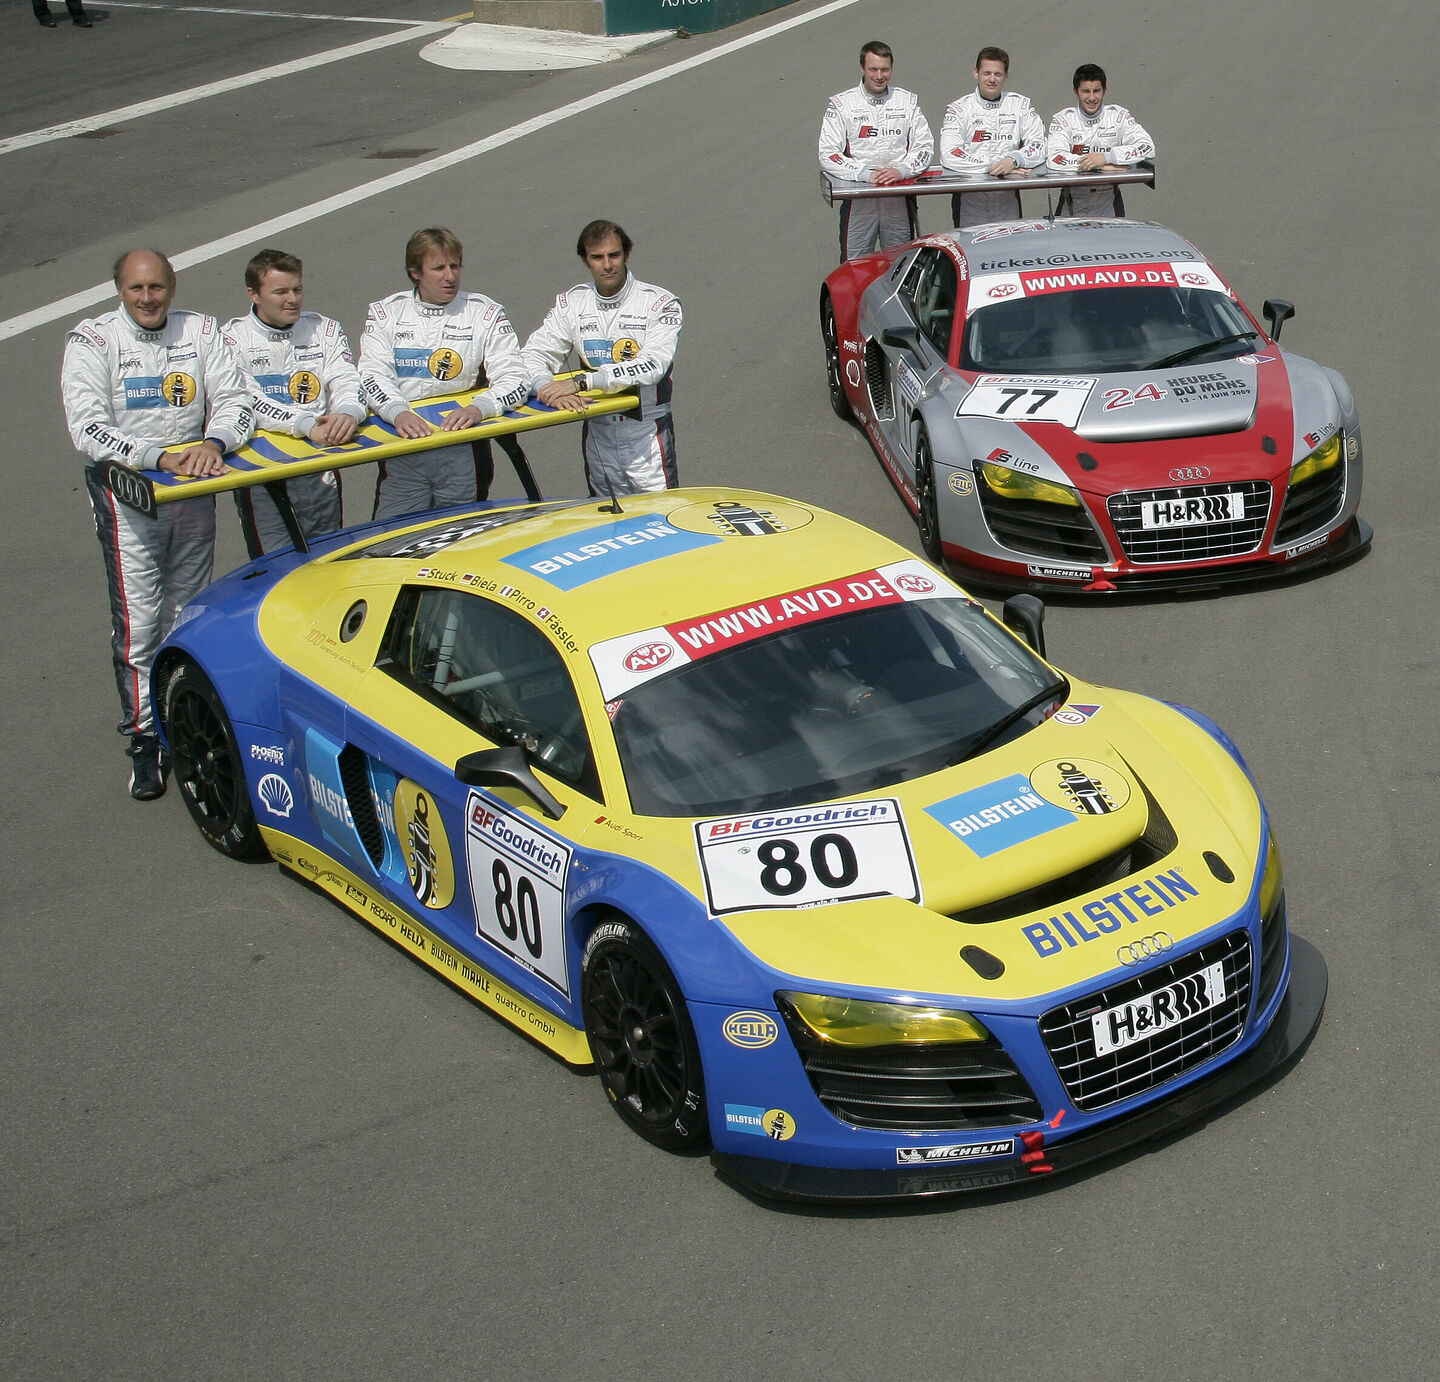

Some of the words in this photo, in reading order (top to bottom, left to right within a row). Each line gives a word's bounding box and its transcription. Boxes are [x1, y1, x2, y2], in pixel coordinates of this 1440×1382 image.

[979, 248, 1195, 272] ticket@lemans.org
[1025, 269, 1175, 292] WWW.AVD.DE
[612, 359, 657, 378] BISTEIN
[984, 376, 1090, 387] BFGoodrich
[1167, 372, 1227, 388] HEURES
[995, 388, 1059, 416] 77
[1102, 382, 1169, 413] 24
[1174, 383, 1198, 398] DU
[1200, 379, 1247, 395] MANS
[1209, 391, 1229, 400] JUIN
[1230, 388, 1252, 397] 2009
[1320, 422, 1335, 438] line
[1013, 456, 1040, 472] line
[530, 521, 679, 576] BILSTEIN
[427, 568, 458, 582] Stuck
[469, 575, 499, 592] Biela
[1044, 568, 1091, 579] MICHELIN
[509, 588, 537, 610] Pirro
[678, 578, 894, 650] WWW.AVD.DE
[544, 614, 580, 655] Fässler
[709, 805, 887, 837] BFGoodrich
[949, 792, 1045, 837] BILSTEIN
[472, 805, 562, 874] BFGoodrich
[605, 819, 623, 831] Audi
[622, 828, 644, 841] Sport
[757, 833, 859, 896] 80
[492, 858, 543, 960] 80
[1021, 869, 1200, 958] BILSTEIN
[370, 902, 397, 928] RECARO
[400, 923, 426, 950] HELIX
[430, 943, 458, 972] BILSTEIN
[462, 965, 490, 994] MAHLE
[495, 992, 527, 1018] quattro
[528, 1012, 556, 1037] GmbH
[729, 1021, 778, 1039] HELLA
[727, 1113, 761, 1126] BILSTEIN
[926, 1143, 1010, 1159] MICHELIN
